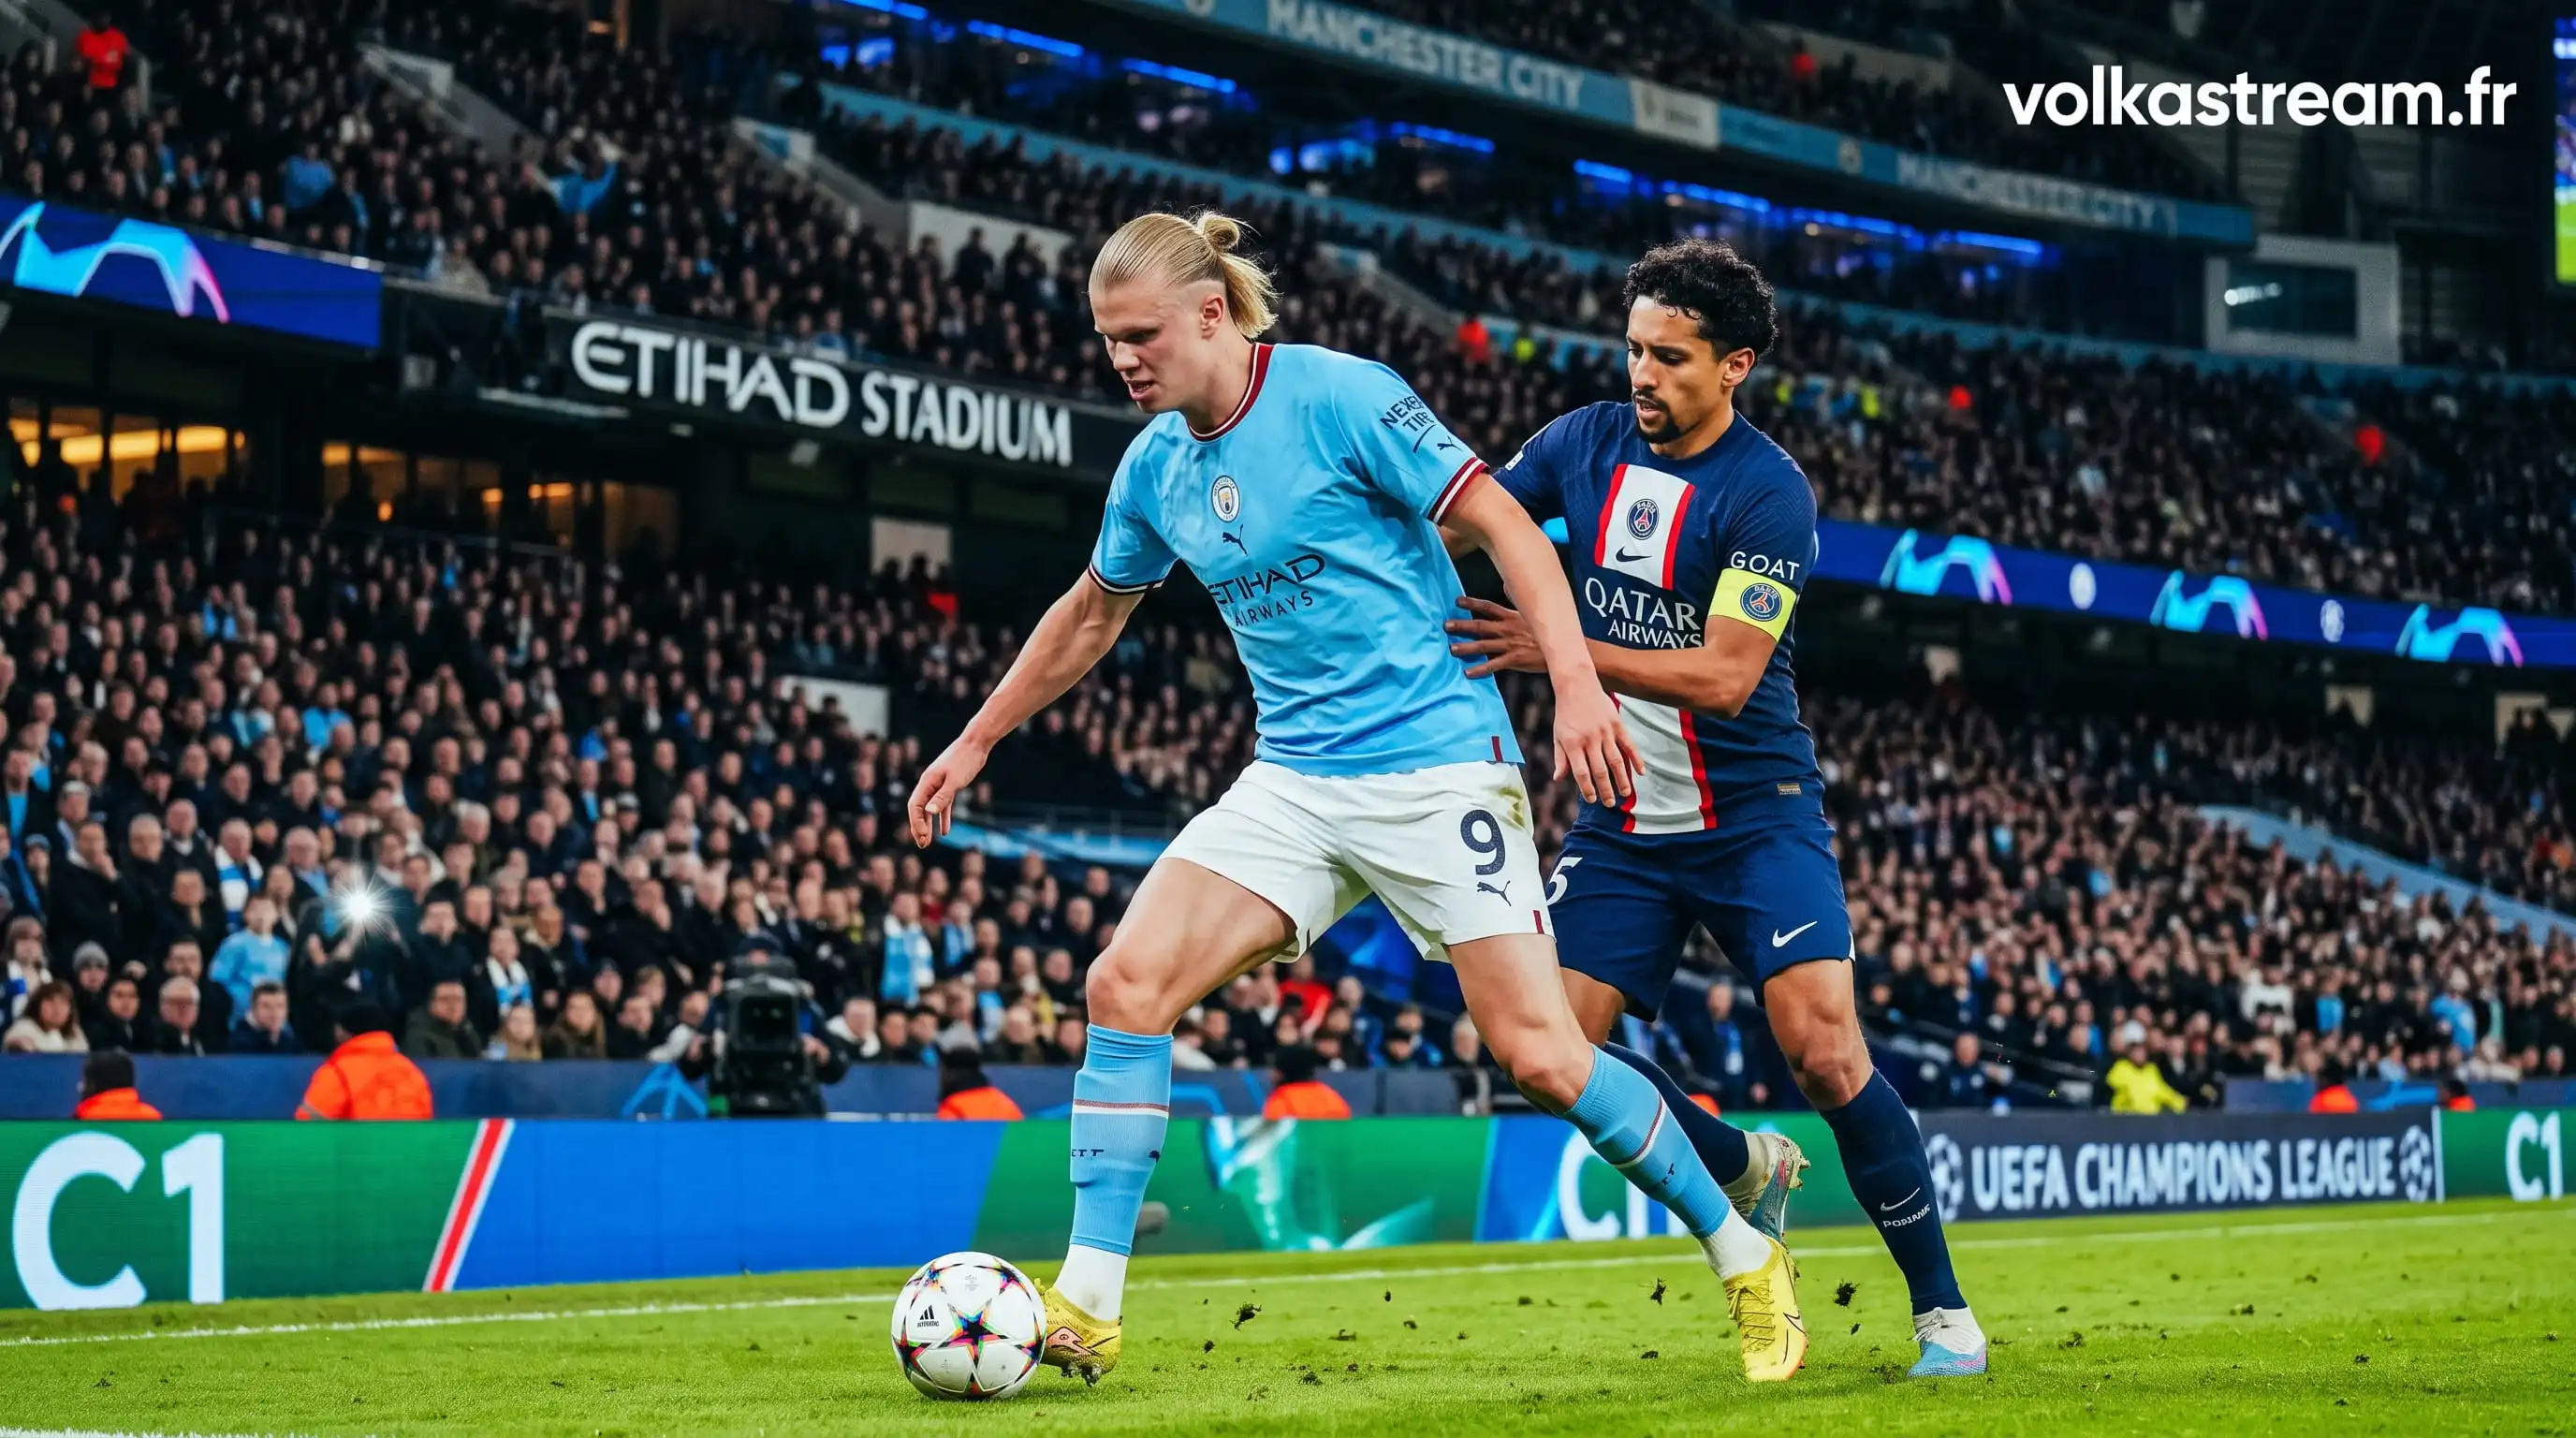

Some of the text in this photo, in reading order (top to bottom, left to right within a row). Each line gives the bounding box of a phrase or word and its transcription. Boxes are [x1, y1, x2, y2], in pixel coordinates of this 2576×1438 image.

[571, 321, 1073, 467] ETIHAD STADIUM
[1208, 553, 1325, 605] ETIHAD
[1730, 550, 1800, 580] GOAT
[1235, 590, 1313, 627] AIRWAYS
[1585, 577, 1701, 631] QATAR
[1607, 619, 1703, 649] AIRWAYS
[1460, 809, 1506, 875] 9
[1545, 856, 1584, 906] 5
[1971, 1136, 2395, 1211] UEFA CHAMPIONS LEAGUE
[2505, 1111, 2563, 1201] C1
[12, 1131, 225, 1311] C1
